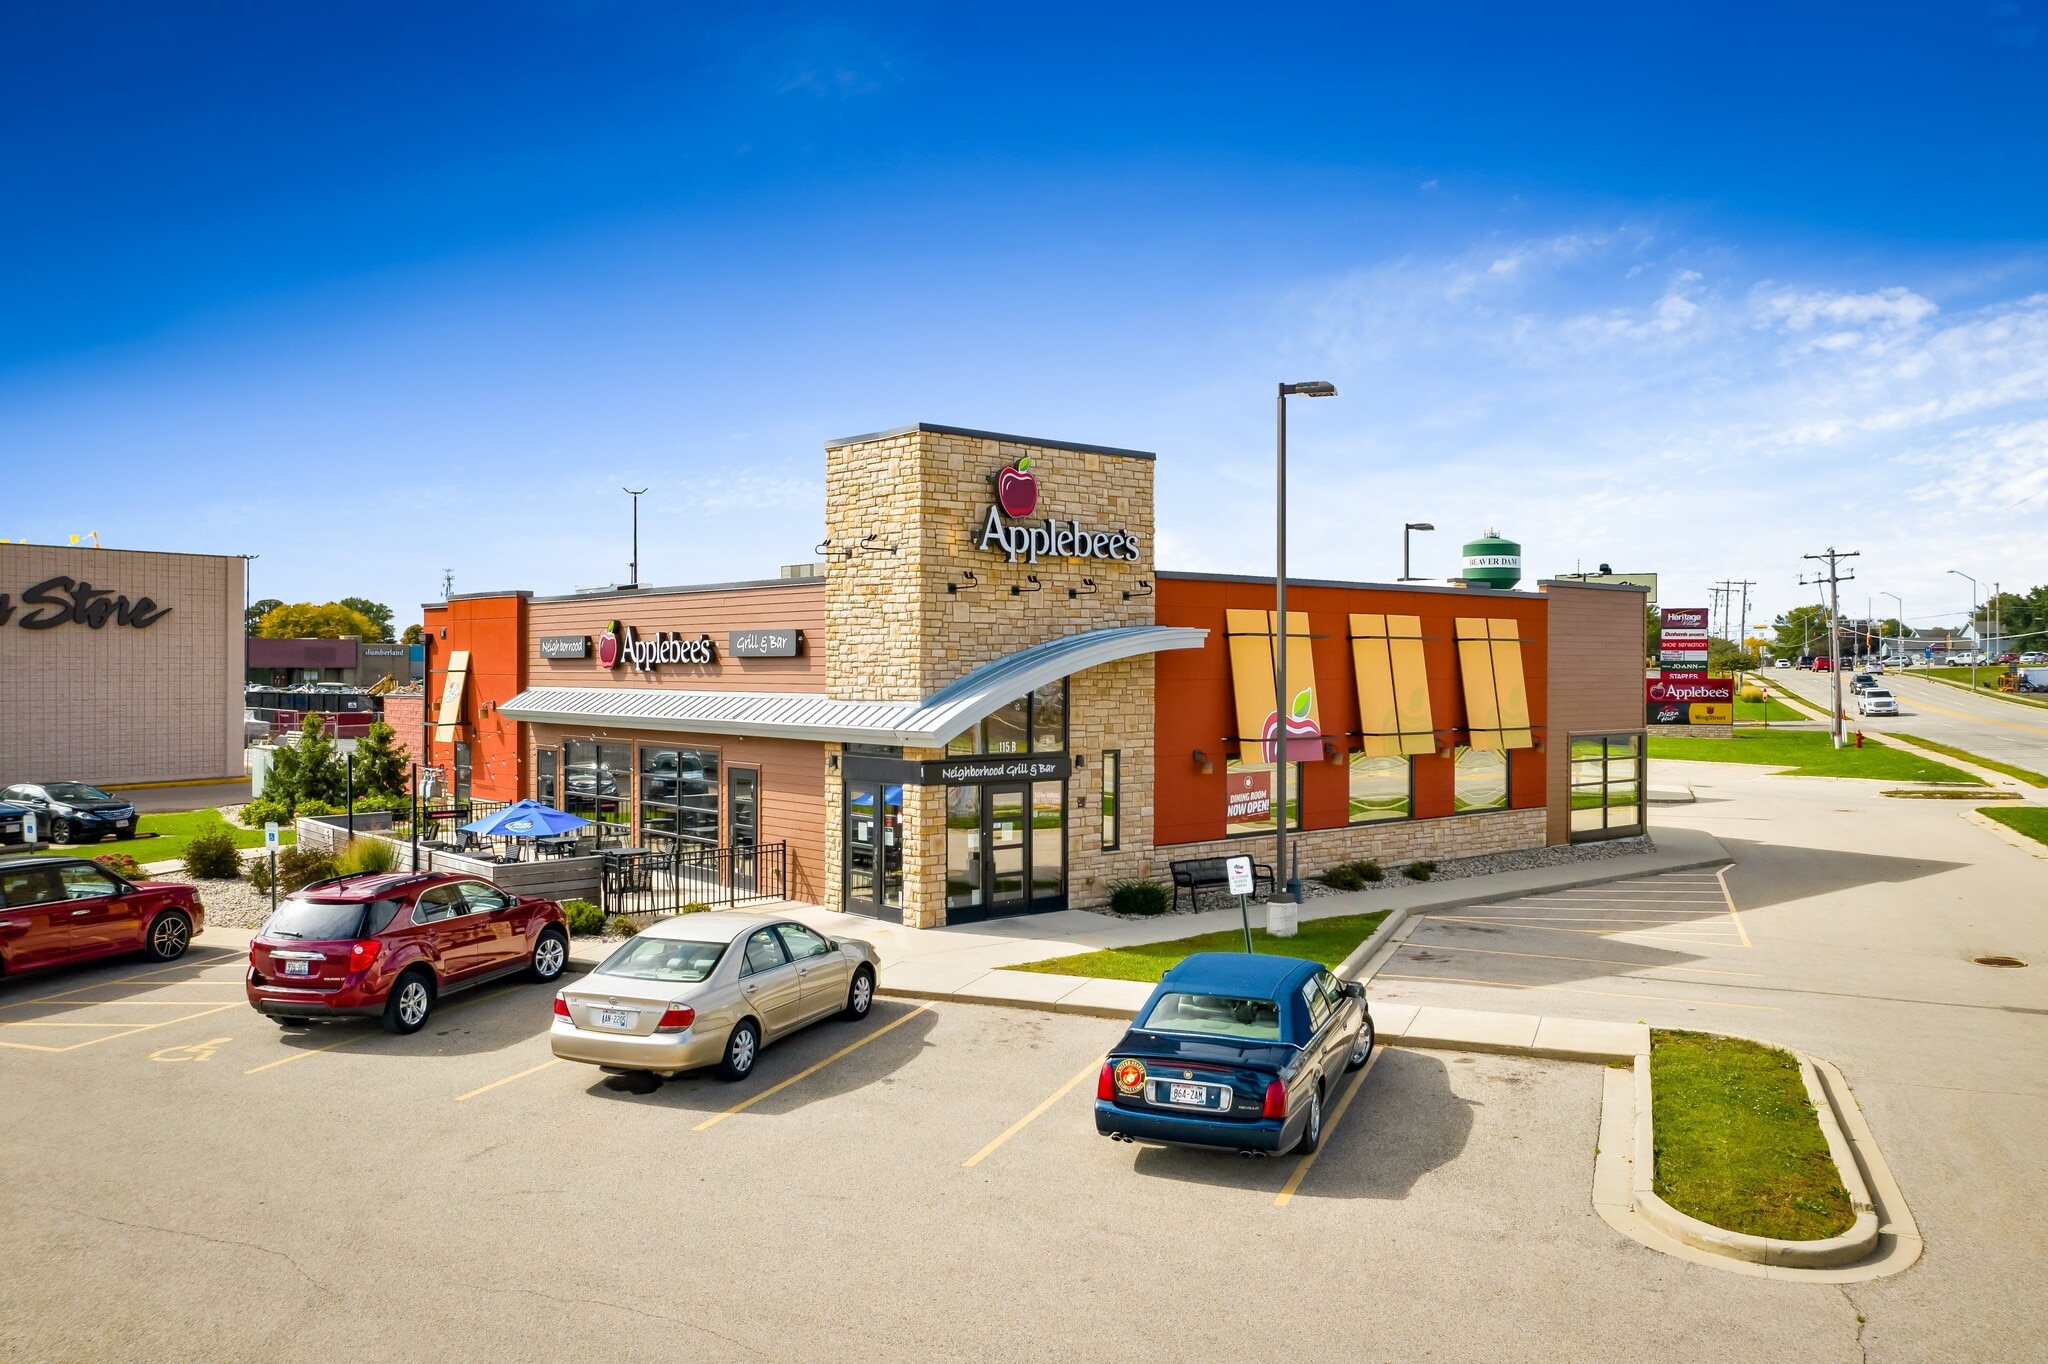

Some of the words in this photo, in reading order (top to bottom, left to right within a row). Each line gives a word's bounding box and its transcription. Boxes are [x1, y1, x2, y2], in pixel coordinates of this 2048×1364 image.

[979, 505, 1140, 564] Applebee's
[1469, 557, 1499, 566] BEAVER
[1502, 557, 1517, 566] DAM
[19, 575, 173, 630] Store
[1667, 613, 1701, 622] Heritage
[542, 638, 583, 656] Neighborhood
[621, 626, 711, 672] Applebee's
[736, 633, 759, 650] Grill
[769, 635, 788, 649] Bar
[1666, 684, 1729, 700] Applebee's
[998, 741, 1010, 753] 115
[1011, 741, 1017, 752] B
[942, 764, 1005, 781] Neighborhood
[1006, 763, 1028, 778] Grill
[1039, 764, 1055, 773] Bar
[1230, 793, 1250, 803] DINING
[1251, 790, 1266, 800] ROOM
[1227, 803, 1247, 817] NOW
[1247, 799, 1270, 814] OPEN!
